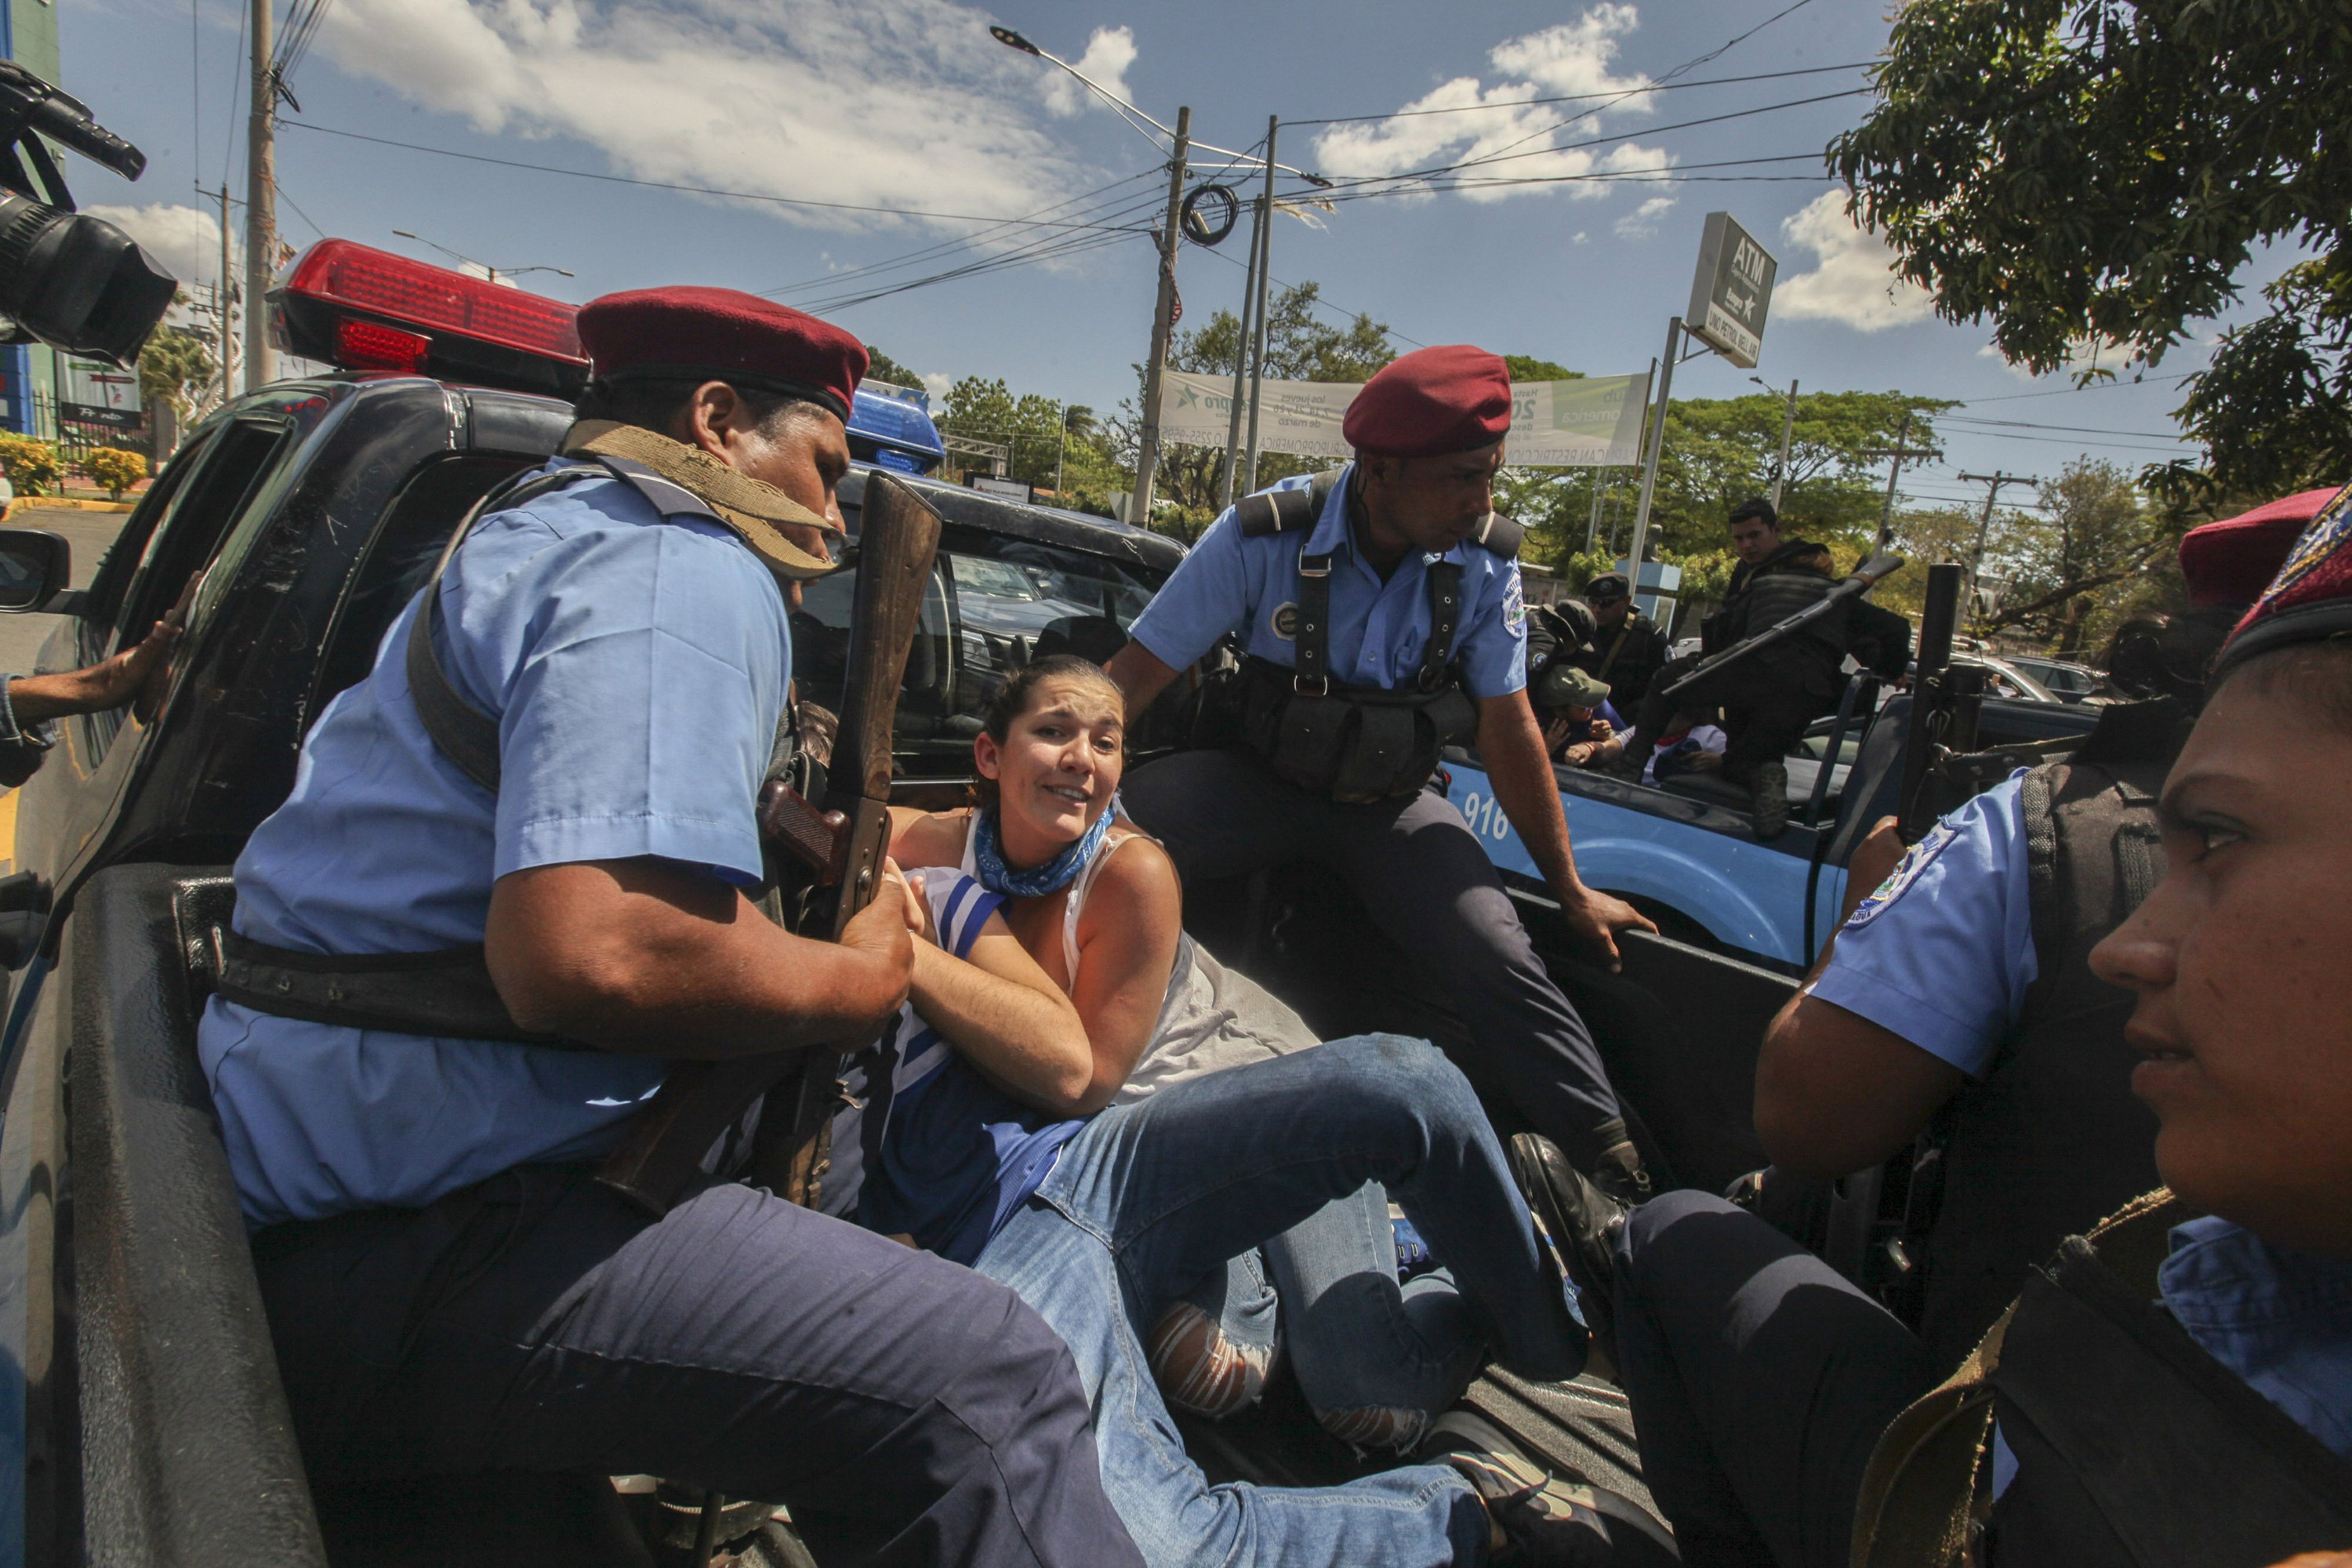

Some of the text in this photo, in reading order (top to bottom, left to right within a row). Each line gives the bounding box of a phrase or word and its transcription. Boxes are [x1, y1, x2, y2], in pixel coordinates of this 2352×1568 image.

[1733, 237, 1766, 285] ATM
[1708, 310, 1720, 332] UNO
[1720, 319, 1737, 345] PETROL
[1737, 332, 1748, 353] BELL
[79, 407, 124, 420] Prnto
[1465, 792, 1509, 840] 916
